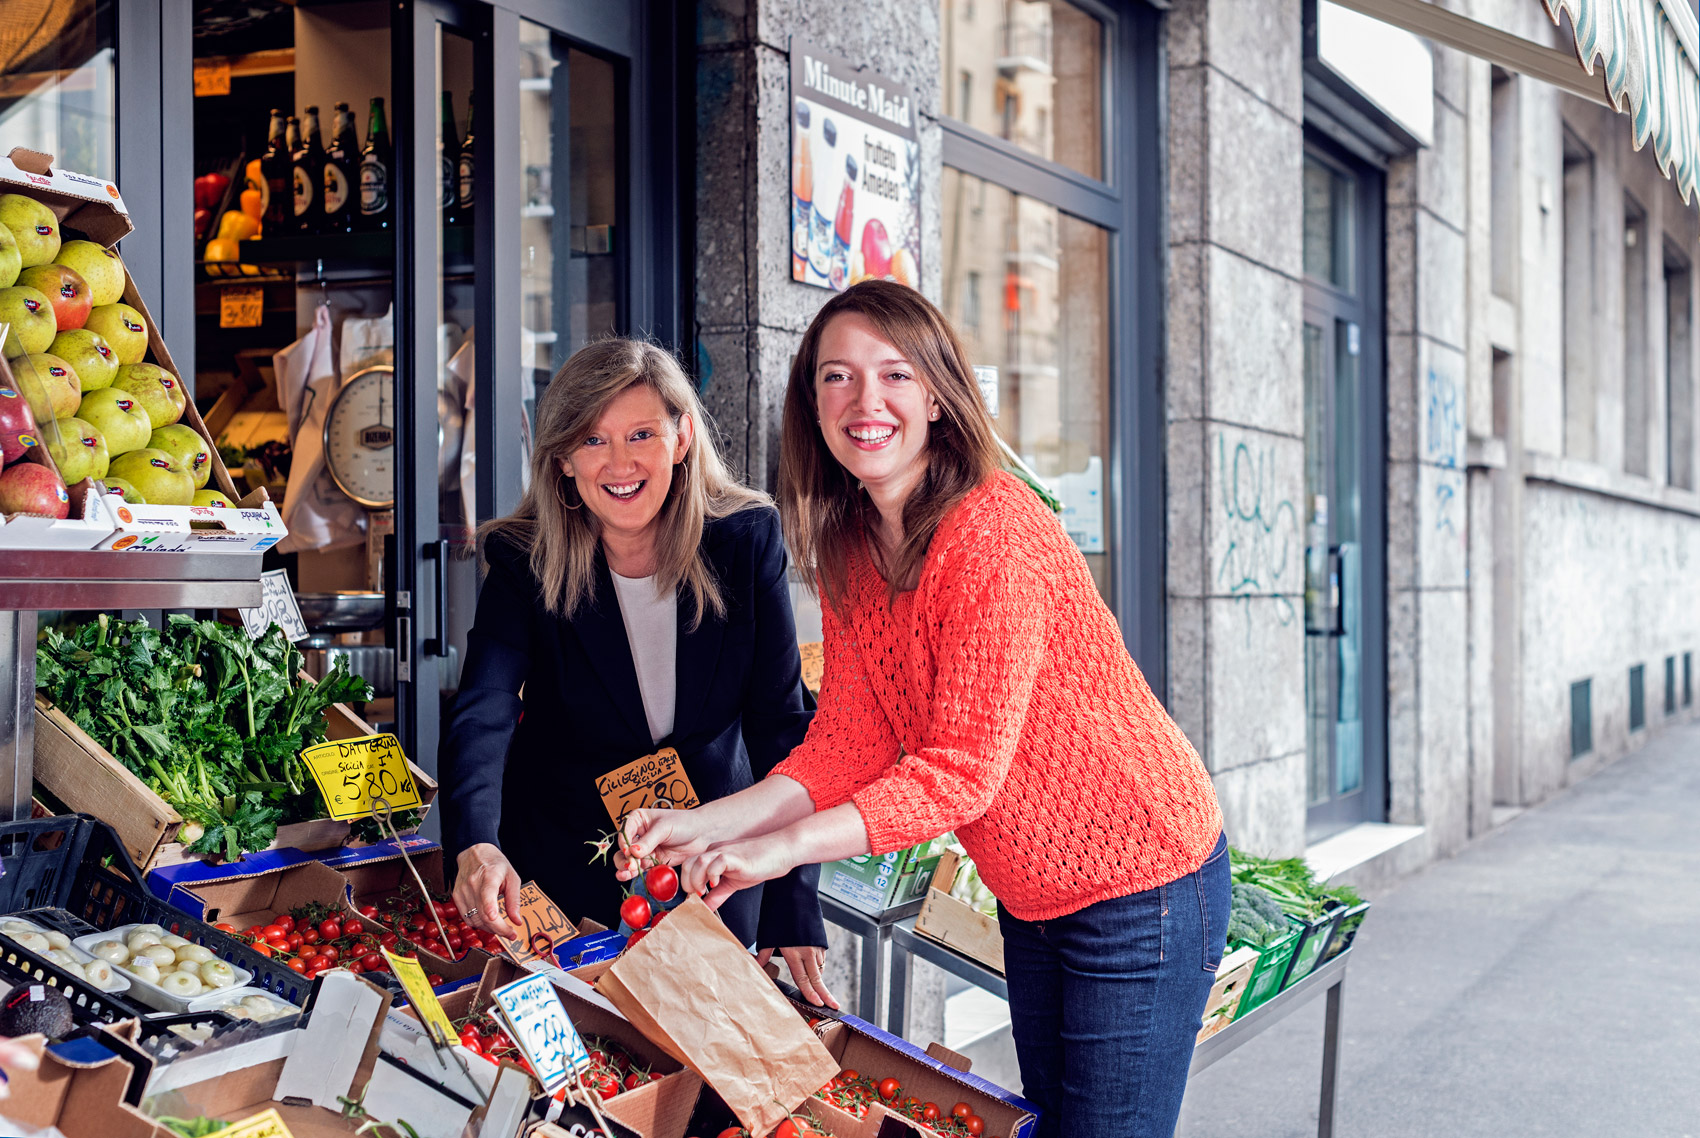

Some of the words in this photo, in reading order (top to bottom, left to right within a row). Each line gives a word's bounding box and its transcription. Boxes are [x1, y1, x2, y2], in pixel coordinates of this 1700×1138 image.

[804, 55, 867, 110] Minute
[867, 83, 911, 128] Maid
[862, 163, 900, 202] Amedeo
[364, 430, 392, 444] BIZERBA
[334, 794, 344, 805] €
[876, 877, 887, 888] 12
